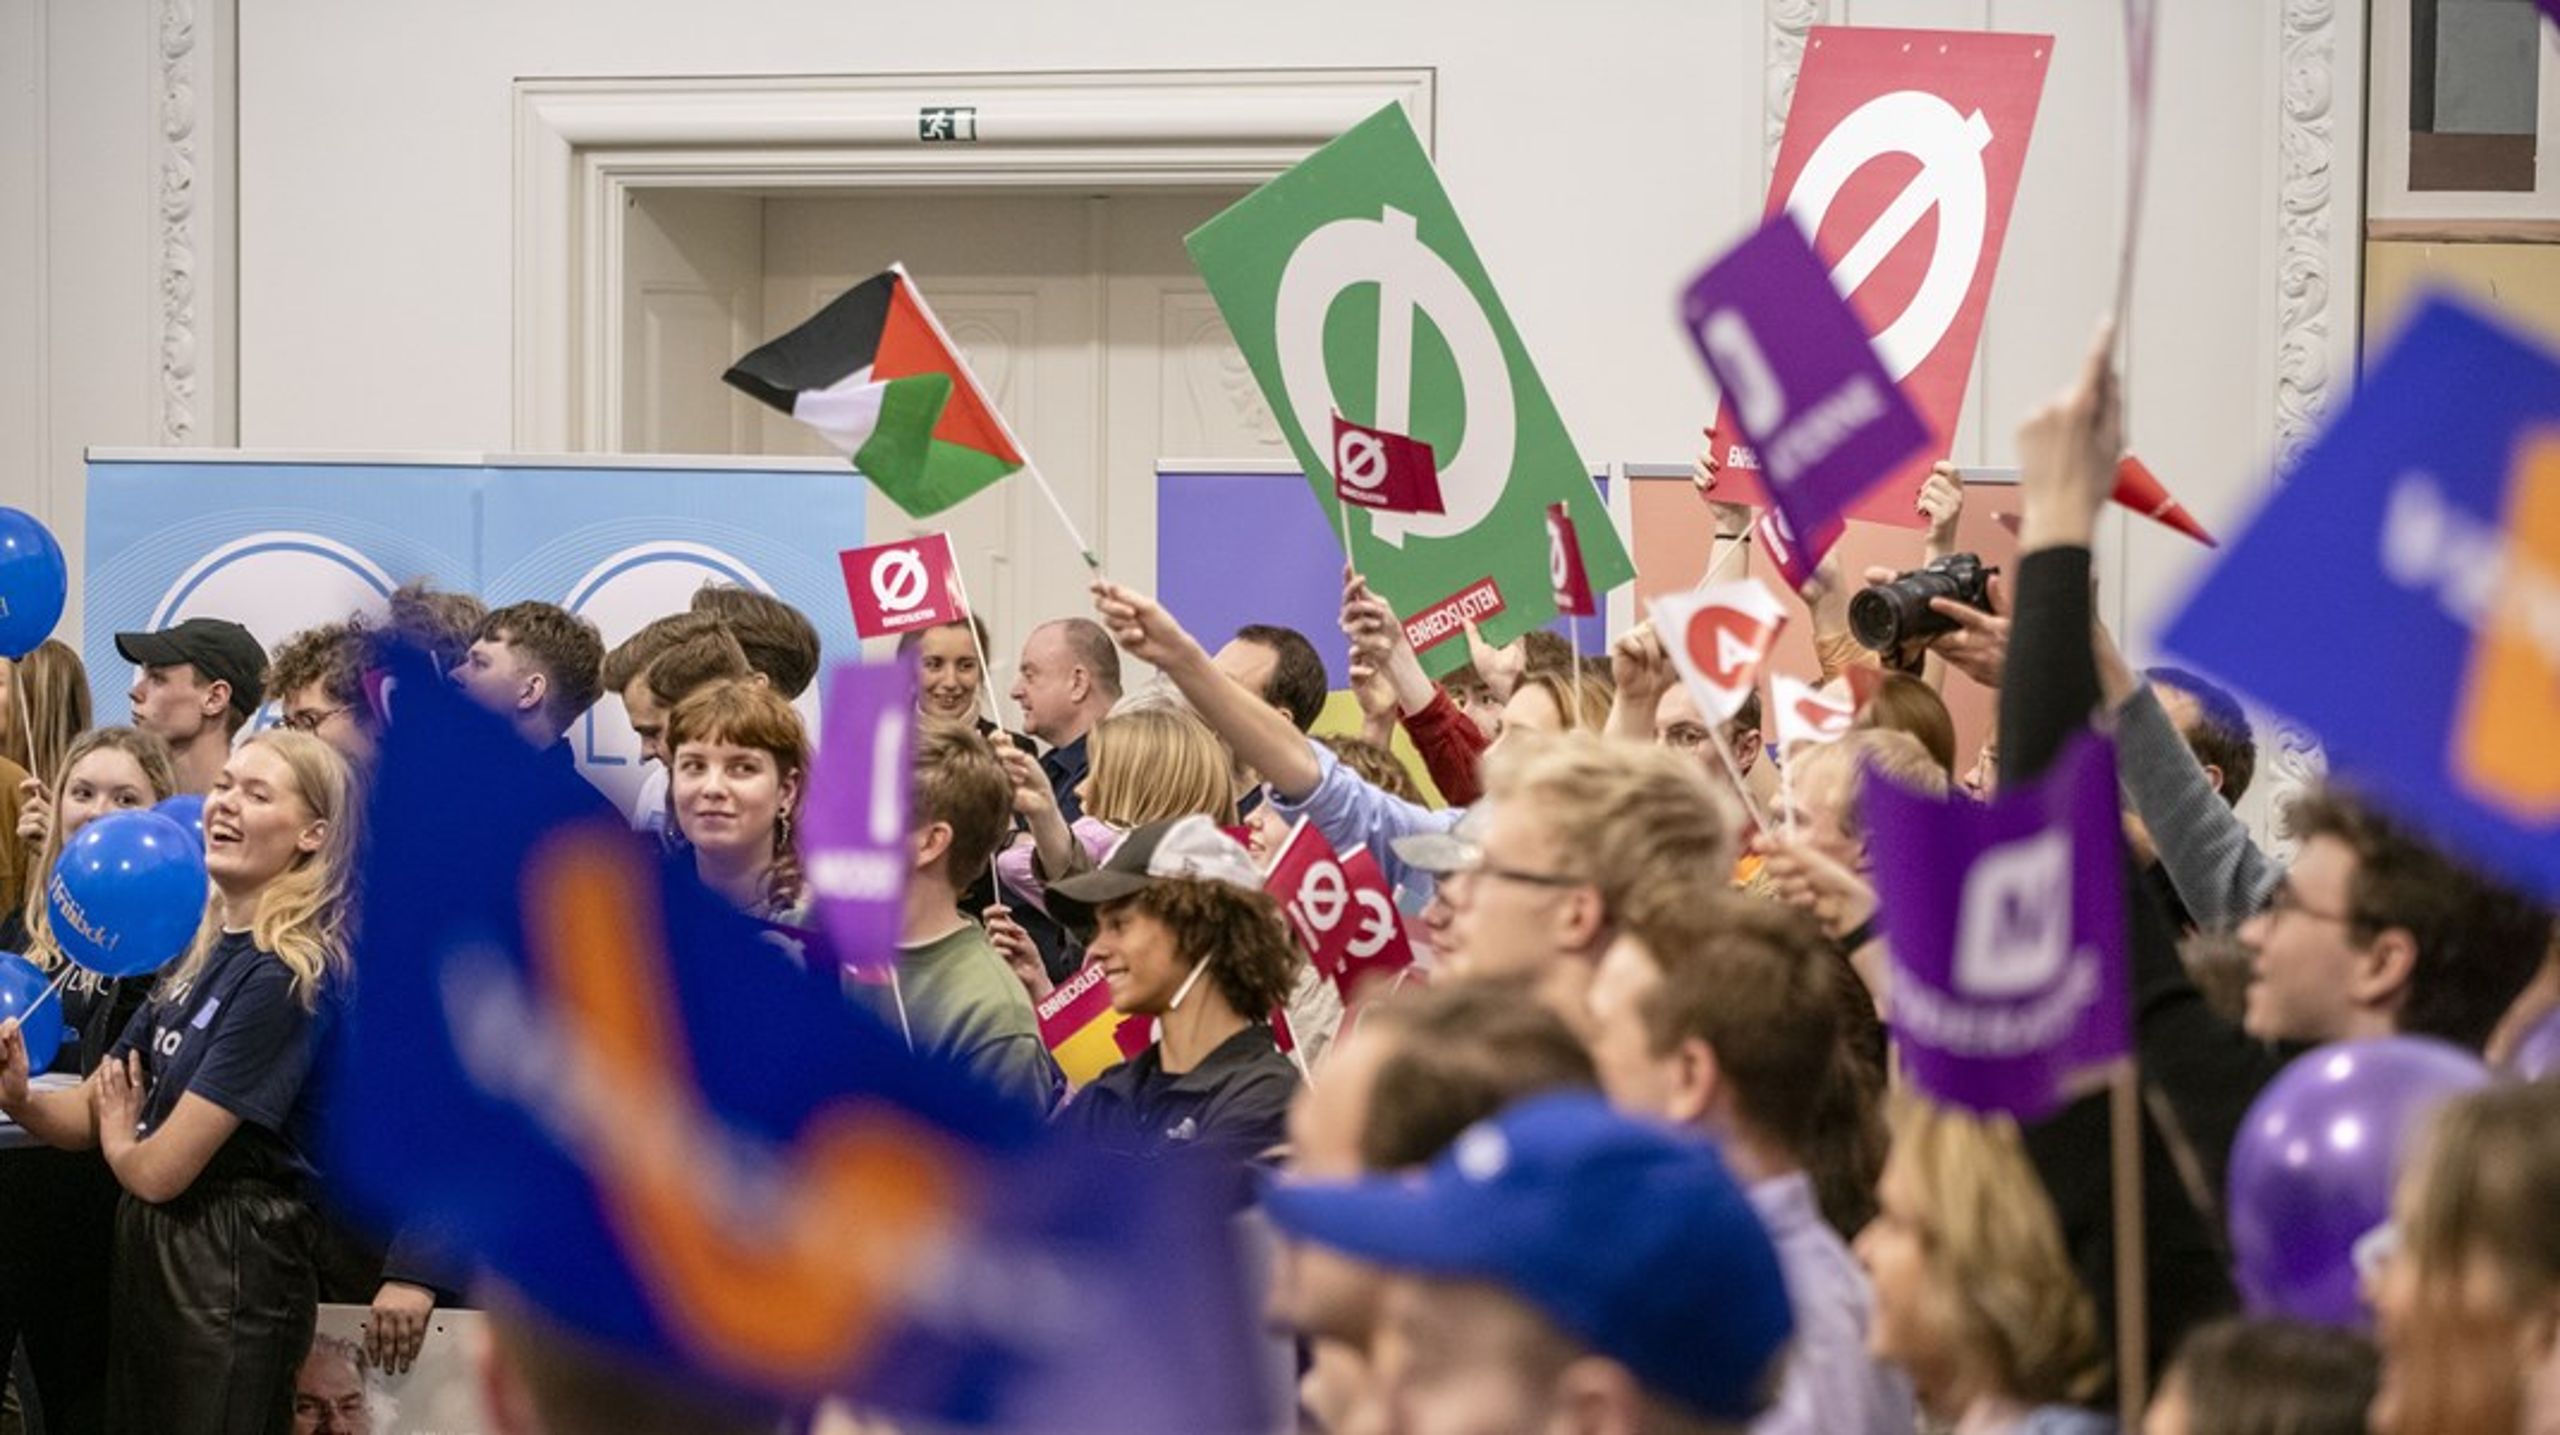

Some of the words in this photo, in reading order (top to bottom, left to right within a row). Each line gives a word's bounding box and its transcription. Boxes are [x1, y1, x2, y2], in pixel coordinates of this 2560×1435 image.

[1275, 203, 1516, 549] Ø
[1338, 430, 1388, 489] Ø
[870, 548, 929, 612] Ø
[1406, 584, 1500, 648] ENHEDSLISTEN
[1297, 859, 1349, 932] Ø
[1037, 963, 1107, 1021] ENHEDSLIST
